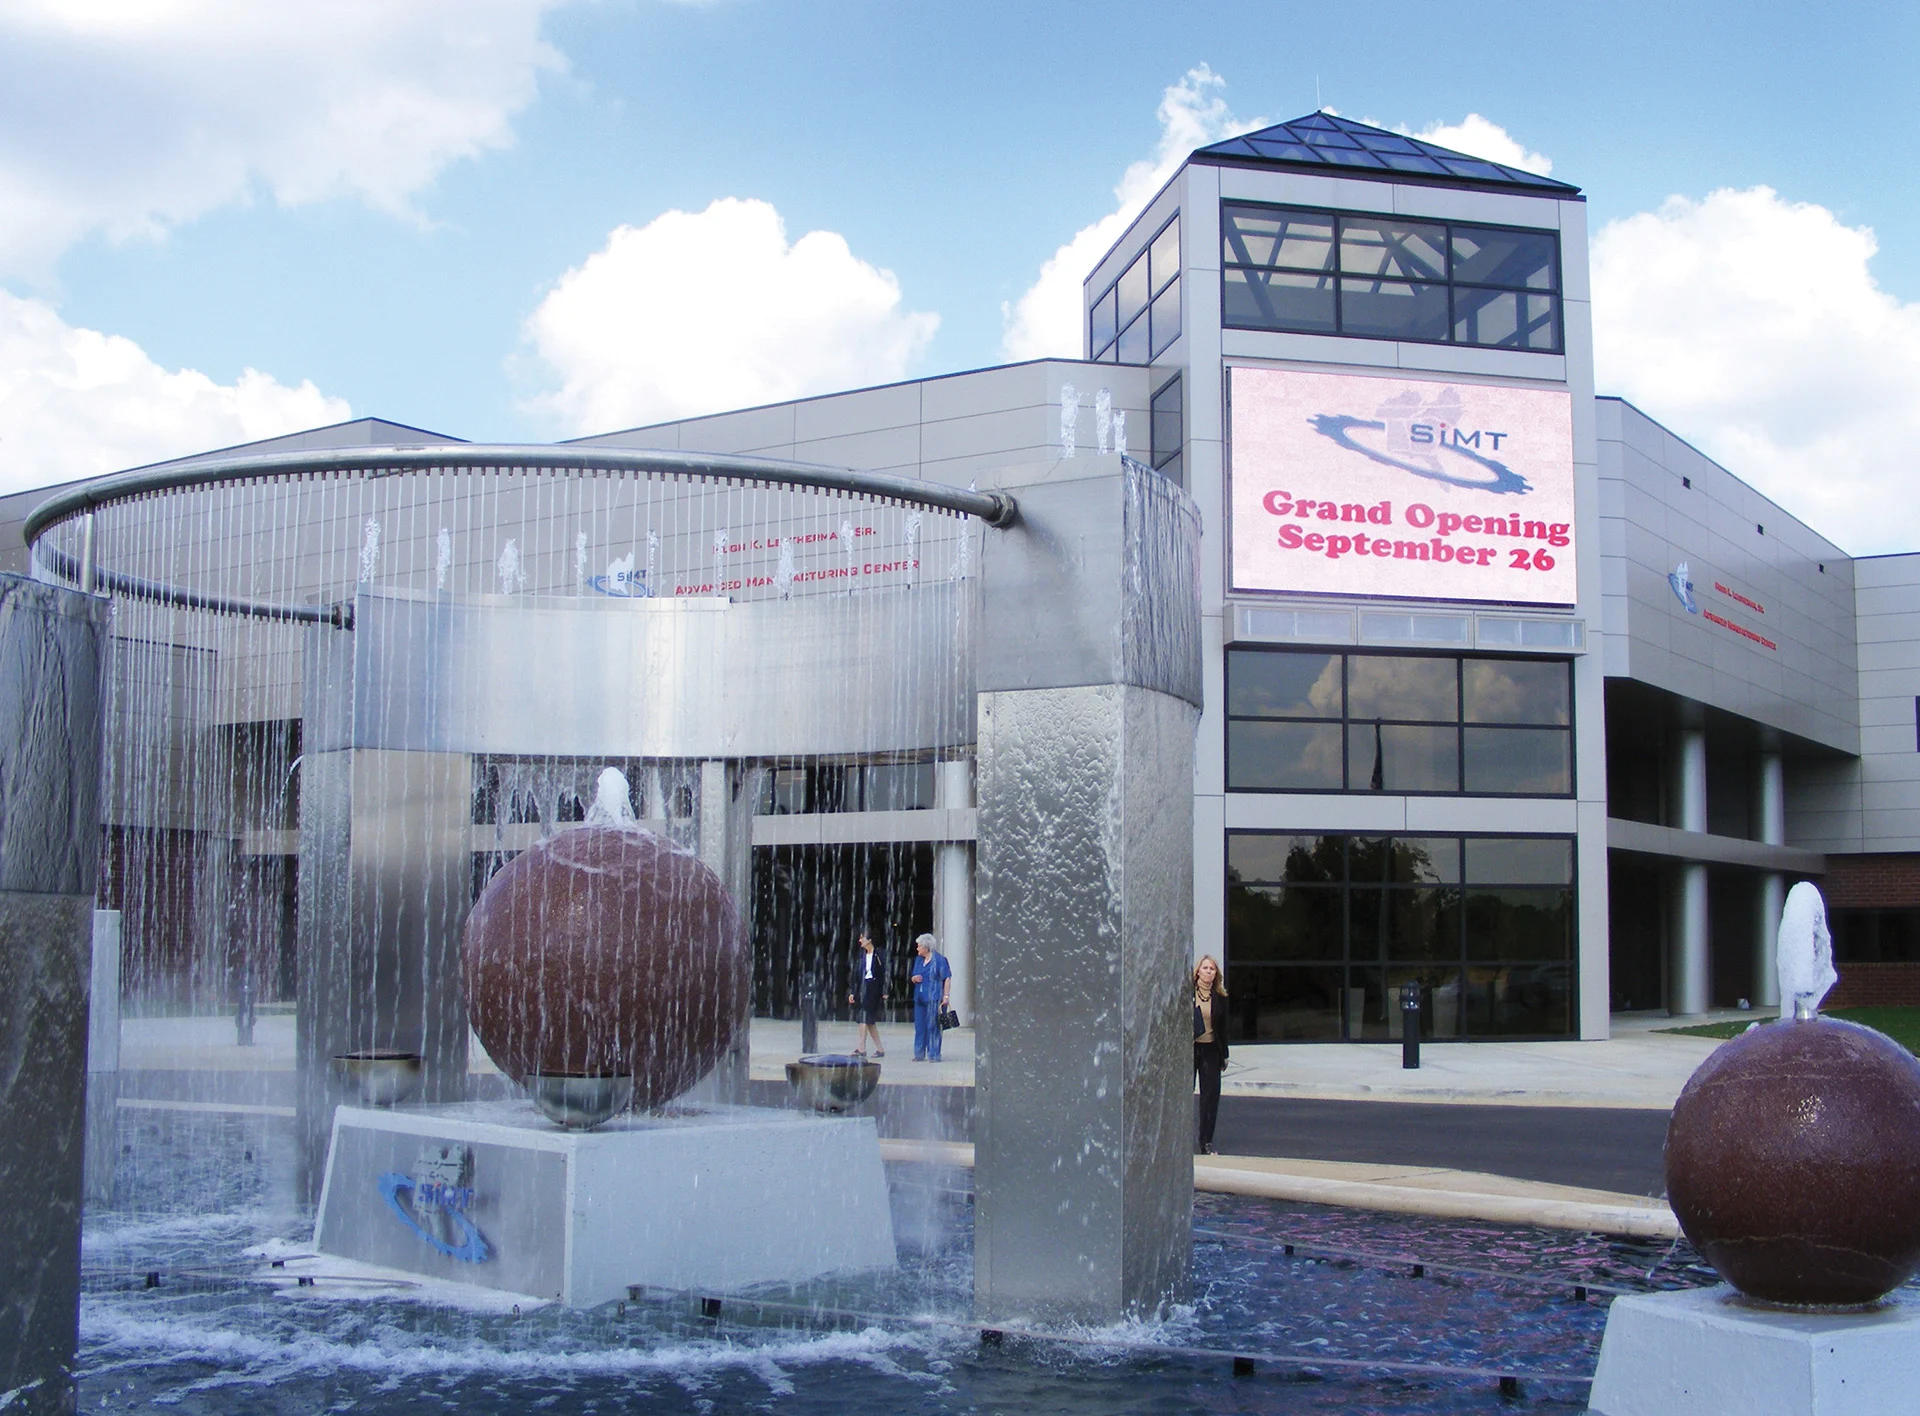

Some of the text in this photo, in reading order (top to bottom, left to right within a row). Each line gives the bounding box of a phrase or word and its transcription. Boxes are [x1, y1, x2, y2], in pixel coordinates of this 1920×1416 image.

[1262, 490, 1570, 547] Grand Opening
[1278, 525, 1556, 571] September 26
[746, 566, 858, 588] MANACTURING
[863, 560, 919, 574] CENTER
